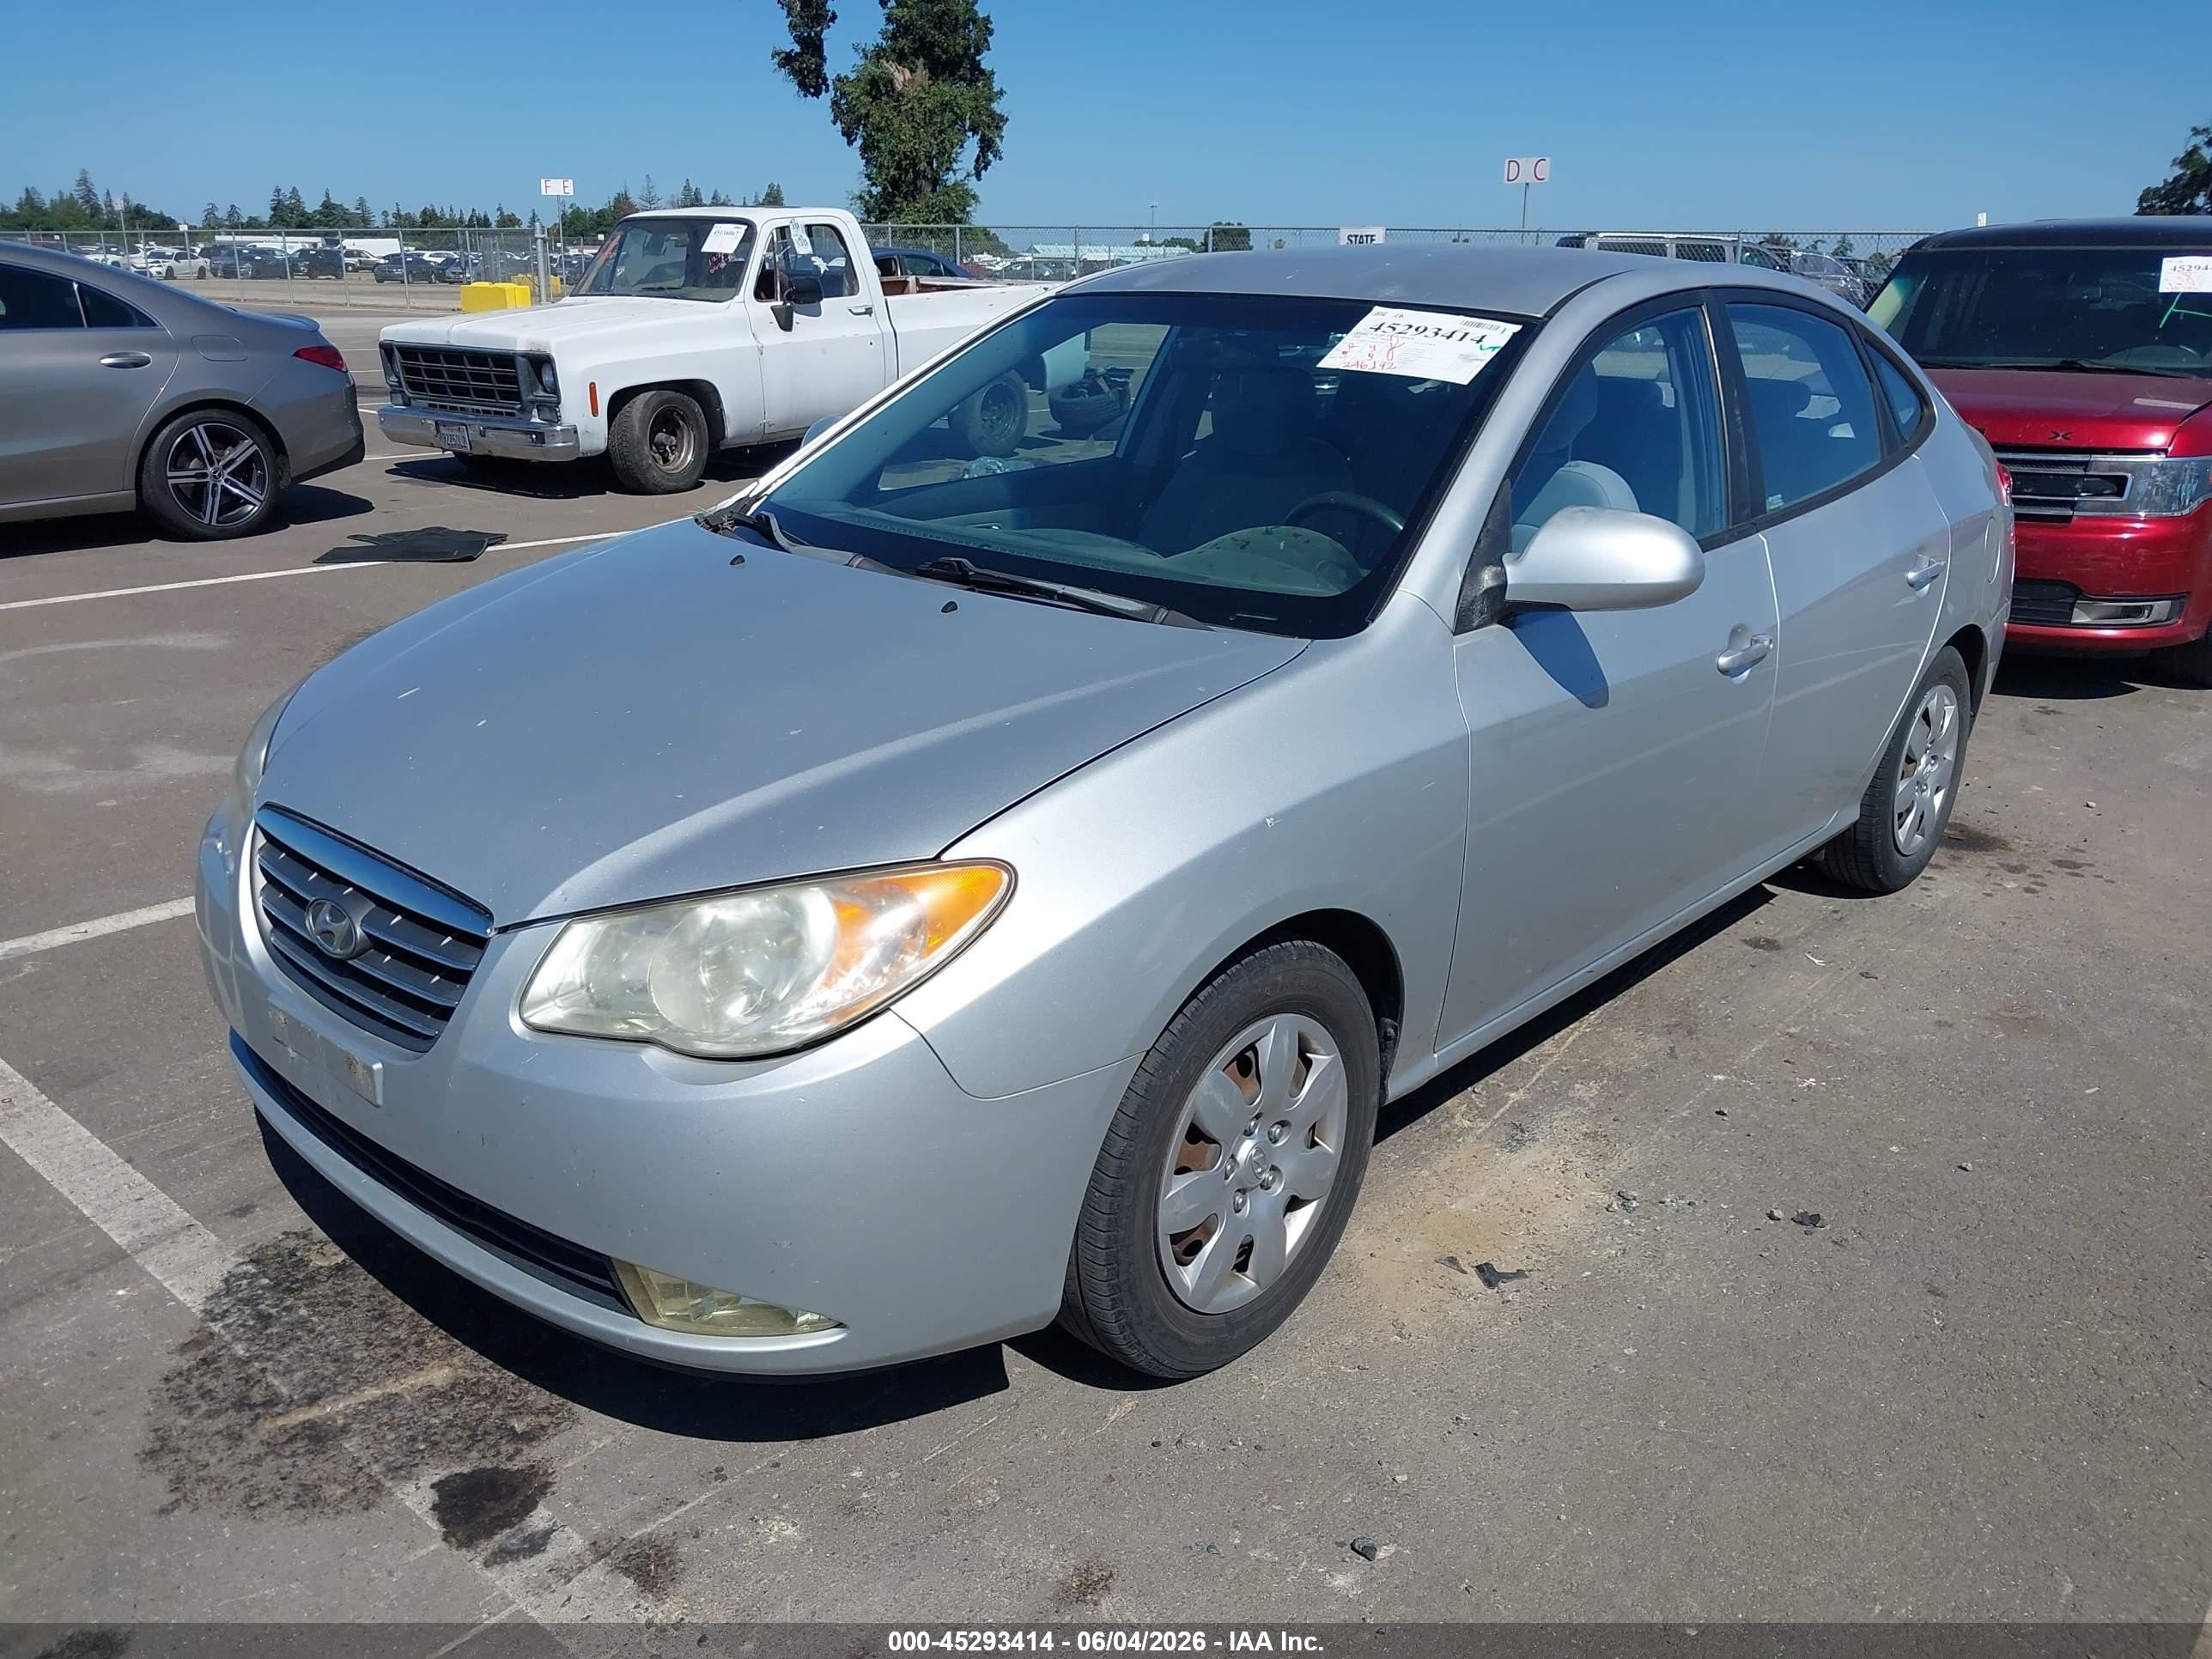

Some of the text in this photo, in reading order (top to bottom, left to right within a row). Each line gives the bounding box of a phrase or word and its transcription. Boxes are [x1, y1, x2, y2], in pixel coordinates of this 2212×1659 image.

[1507, 158, 1547, 181] D C
[544, 179, 571, 194] F E
[1346, 234, 1376, 245] STATE
[1370, 322, 1487, 344] 45293414
